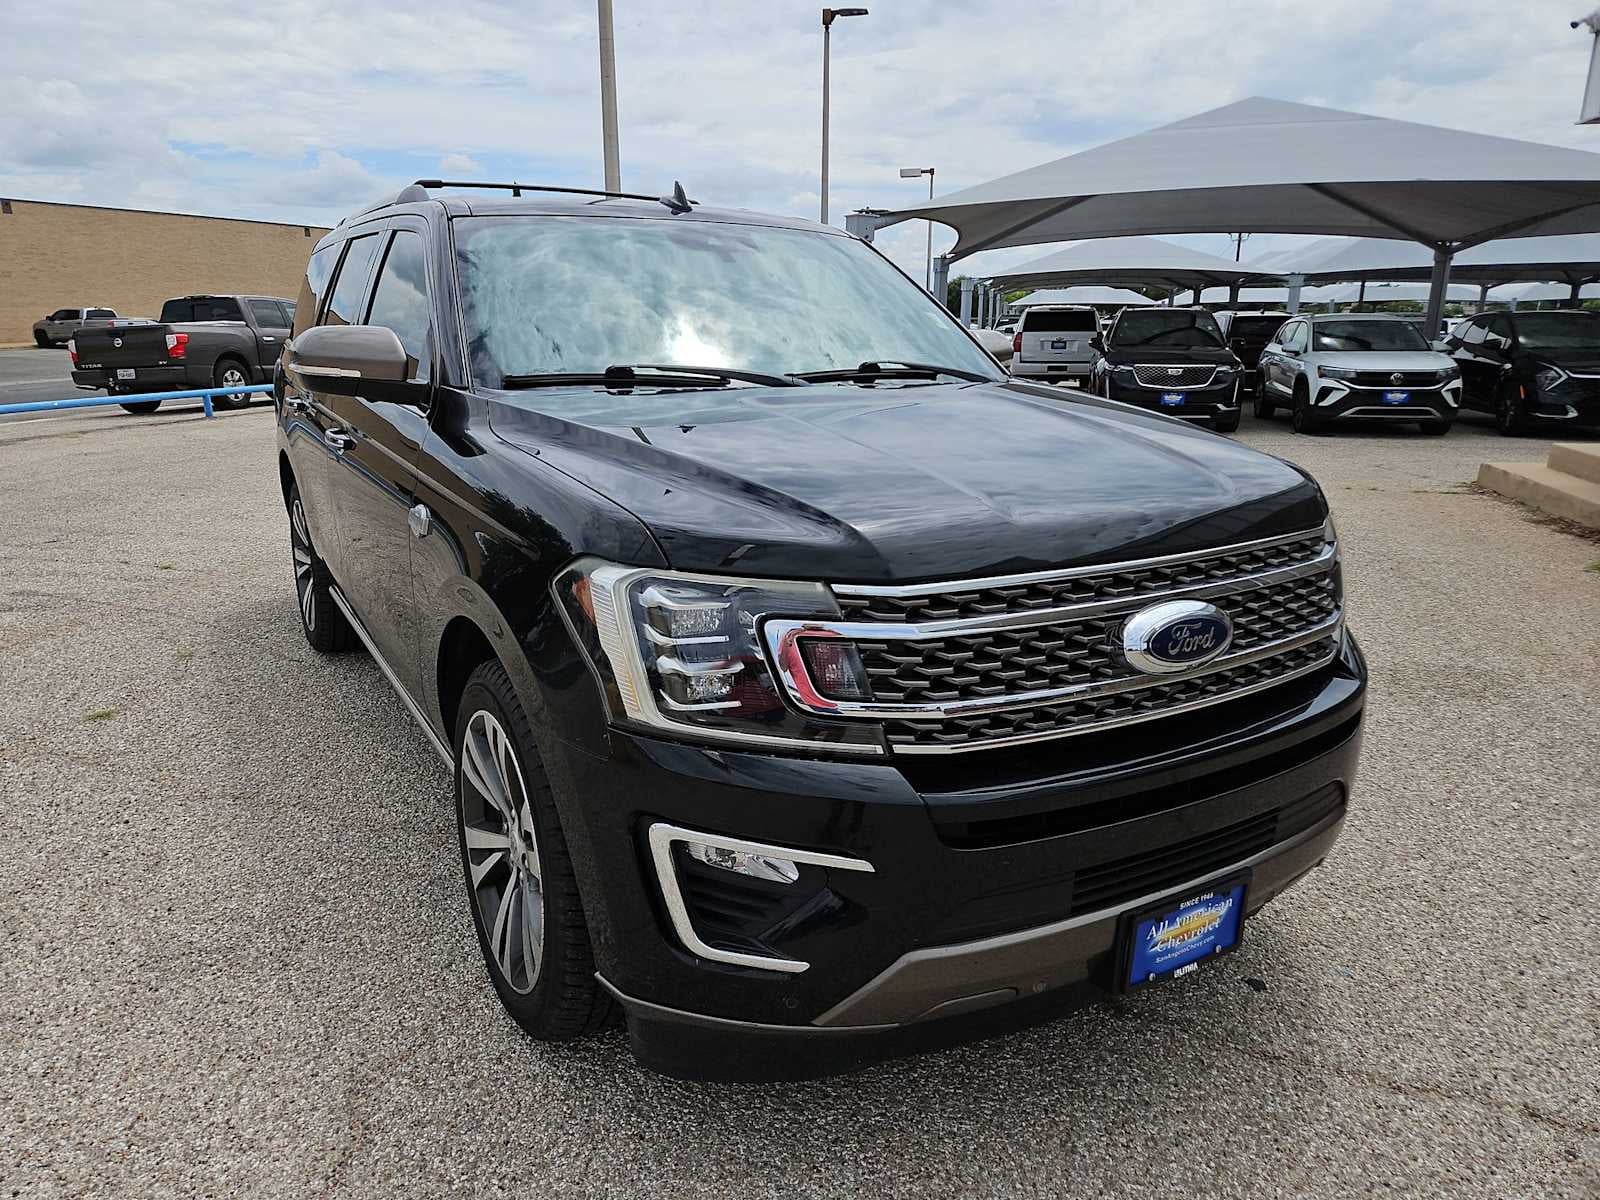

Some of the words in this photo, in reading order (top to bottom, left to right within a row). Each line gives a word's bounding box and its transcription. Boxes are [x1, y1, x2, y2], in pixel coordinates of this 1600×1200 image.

[1168, 622, 1216, 655] Ford
[1147, 920, 1169, 940] All
[1175, 898, 1232, 928] American
[1180, 897, 1200, 910] SINCE
[1157, 918, 1221, 952] Chevrolet
